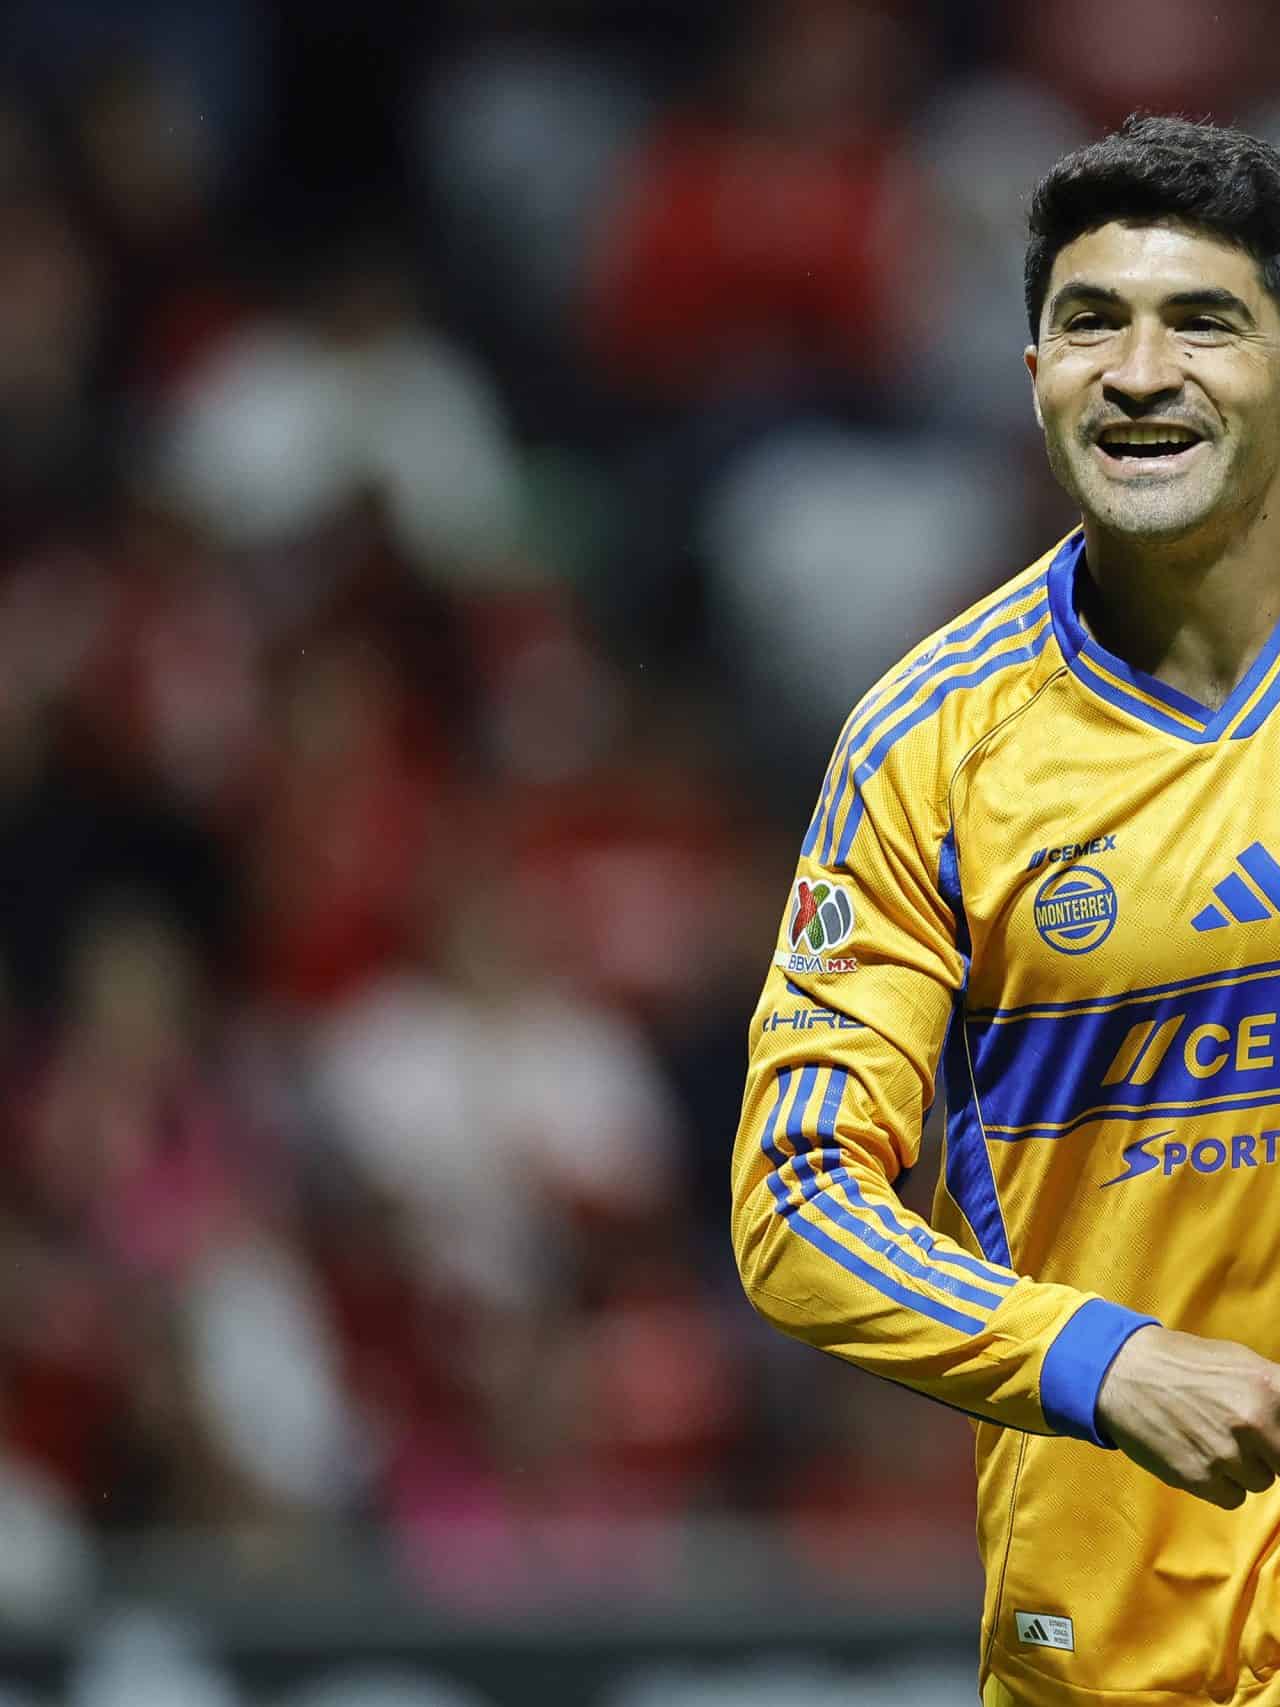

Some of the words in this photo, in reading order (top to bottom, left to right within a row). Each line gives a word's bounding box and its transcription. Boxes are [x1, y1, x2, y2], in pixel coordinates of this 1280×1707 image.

[1047, 834, 1117, 863] CEMEX
[1035, 892, 1113, 928] MONTERREY
[788, 954, 824, 973] BBVA
[828, 959, 857, 972] MX
